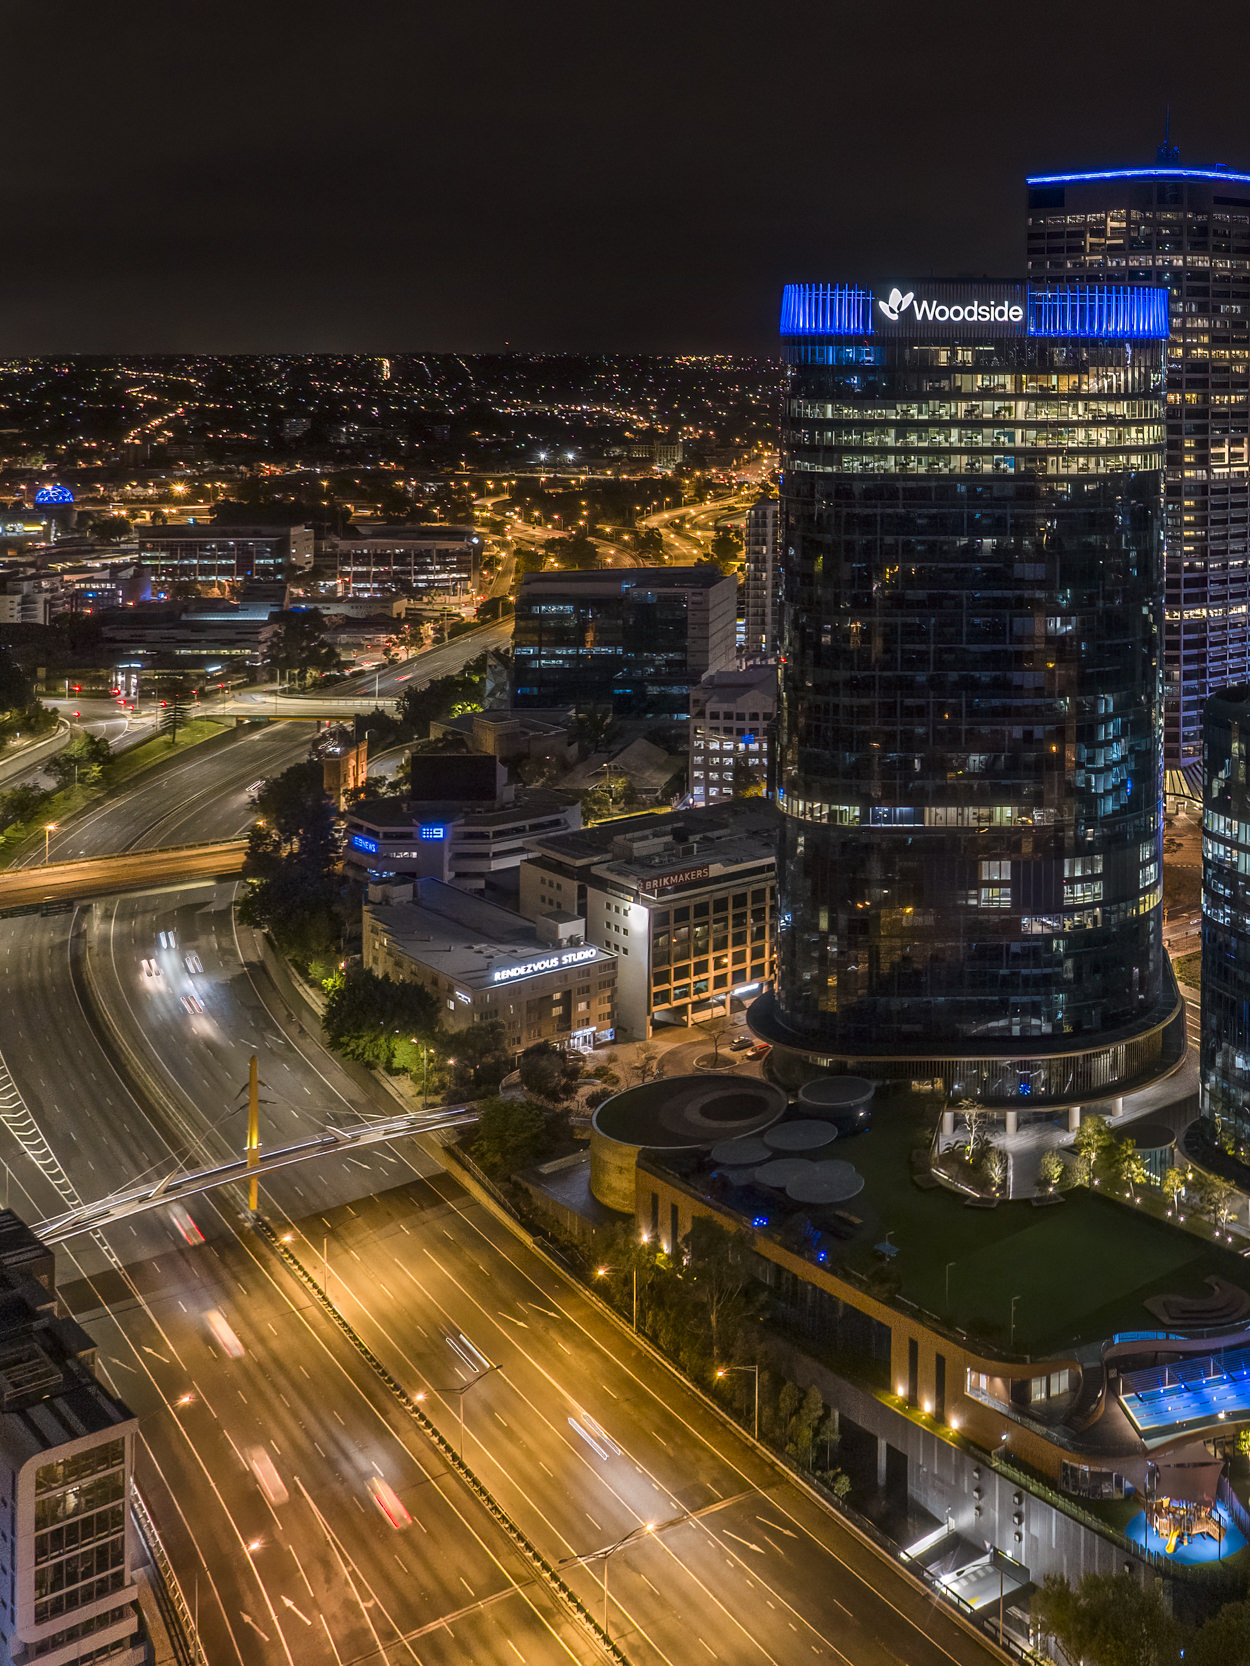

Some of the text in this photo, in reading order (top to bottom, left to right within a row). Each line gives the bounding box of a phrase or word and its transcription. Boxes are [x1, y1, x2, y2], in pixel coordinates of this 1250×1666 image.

[913, 300, 1023, 322] Woodside
[645, 868, 709, 890] BRIKMAKERS
[494, 948, 597, 982] RENDEZVOUS STUDIO
